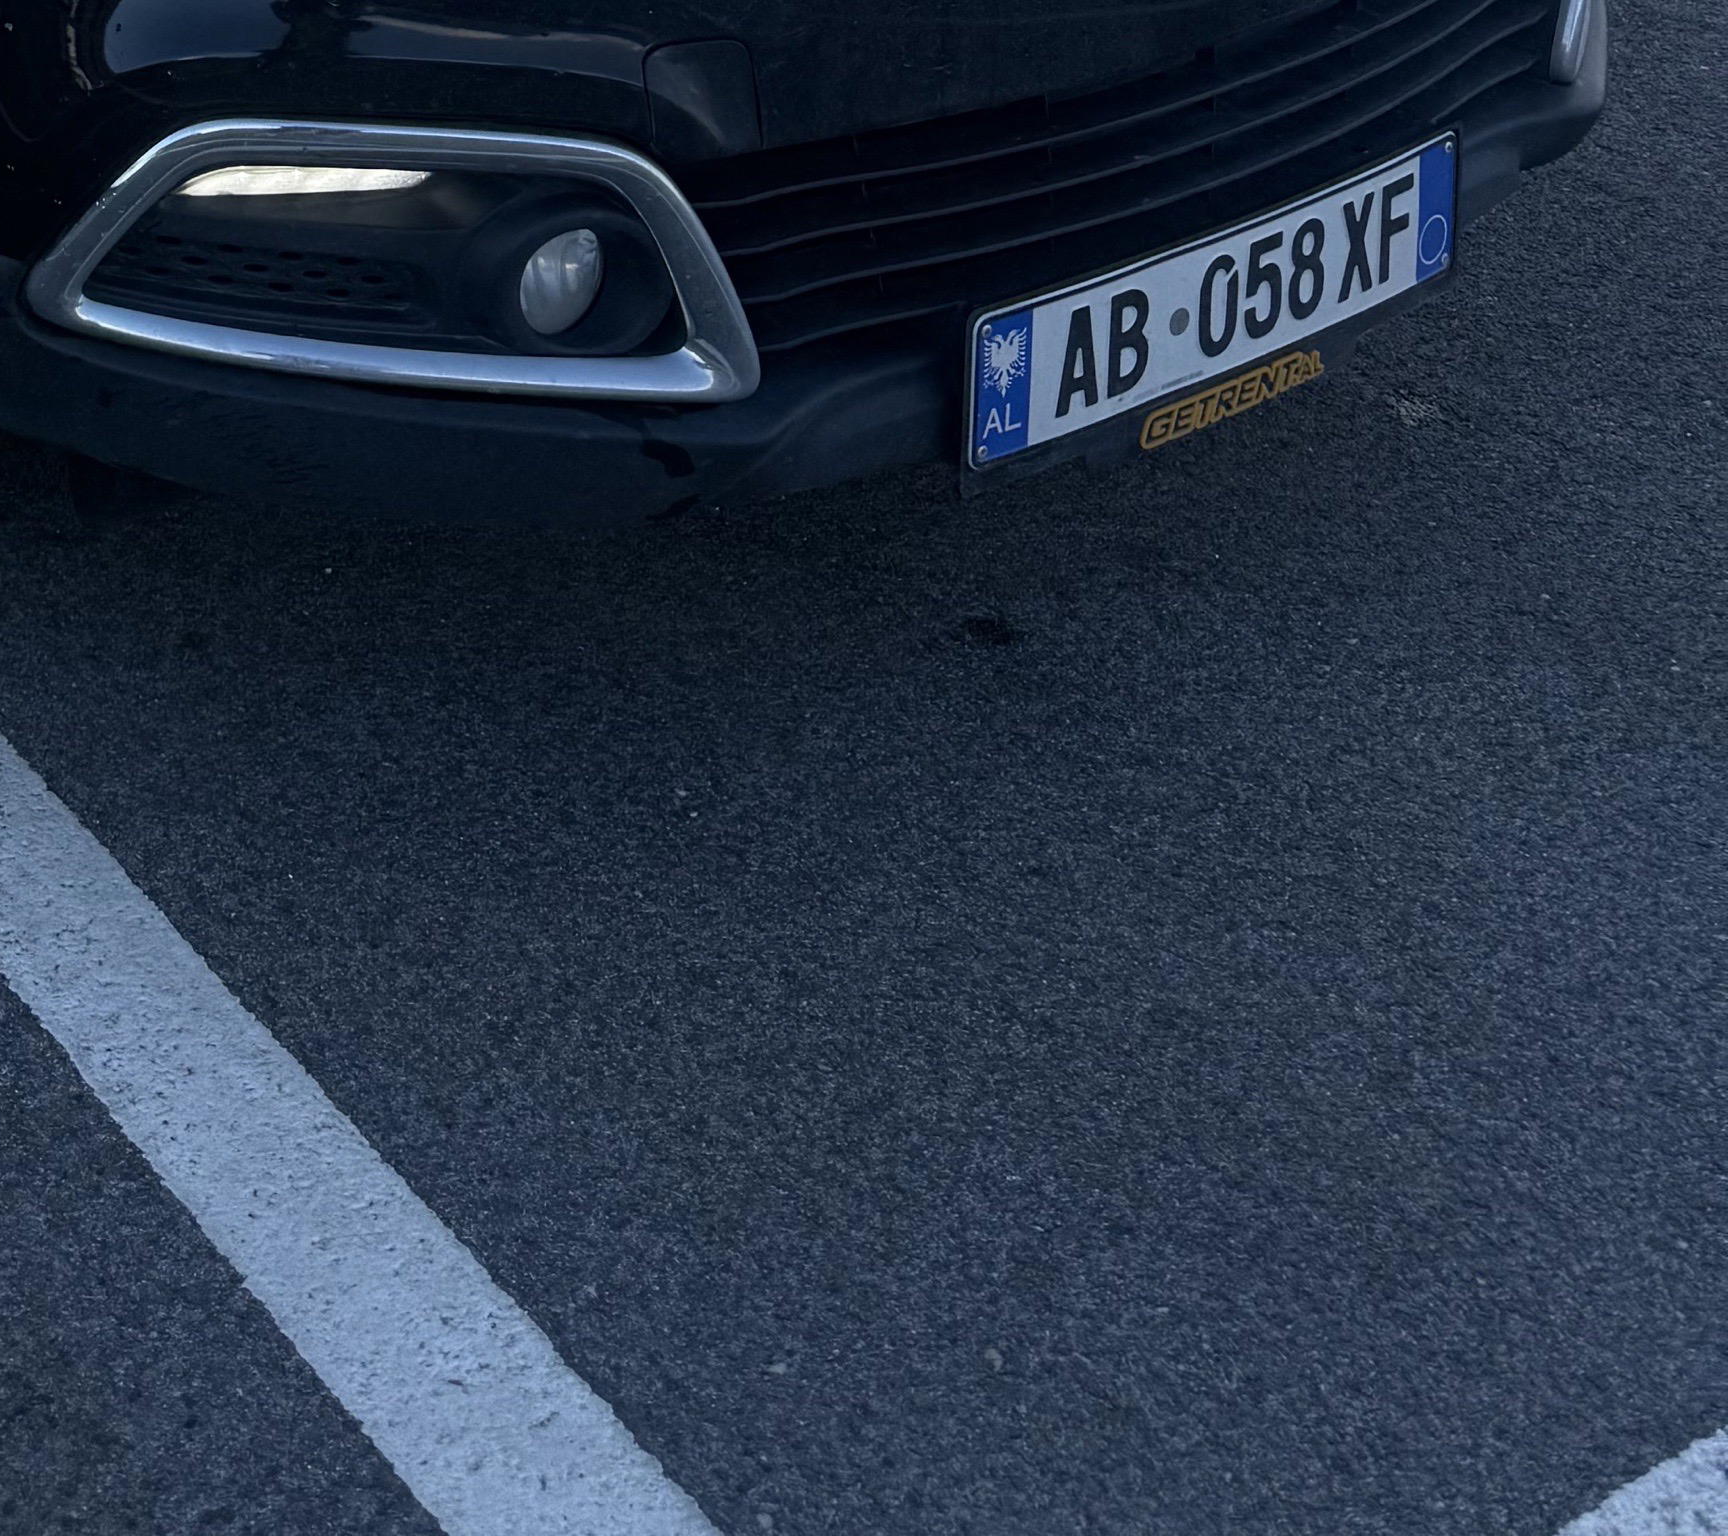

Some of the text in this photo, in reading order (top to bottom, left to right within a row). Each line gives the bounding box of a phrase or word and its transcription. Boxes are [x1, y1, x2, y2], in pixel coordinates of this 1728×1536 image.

[1054, 172, 1415, 419] AB 058 XF
[982, 403, 1022, 439] AL
